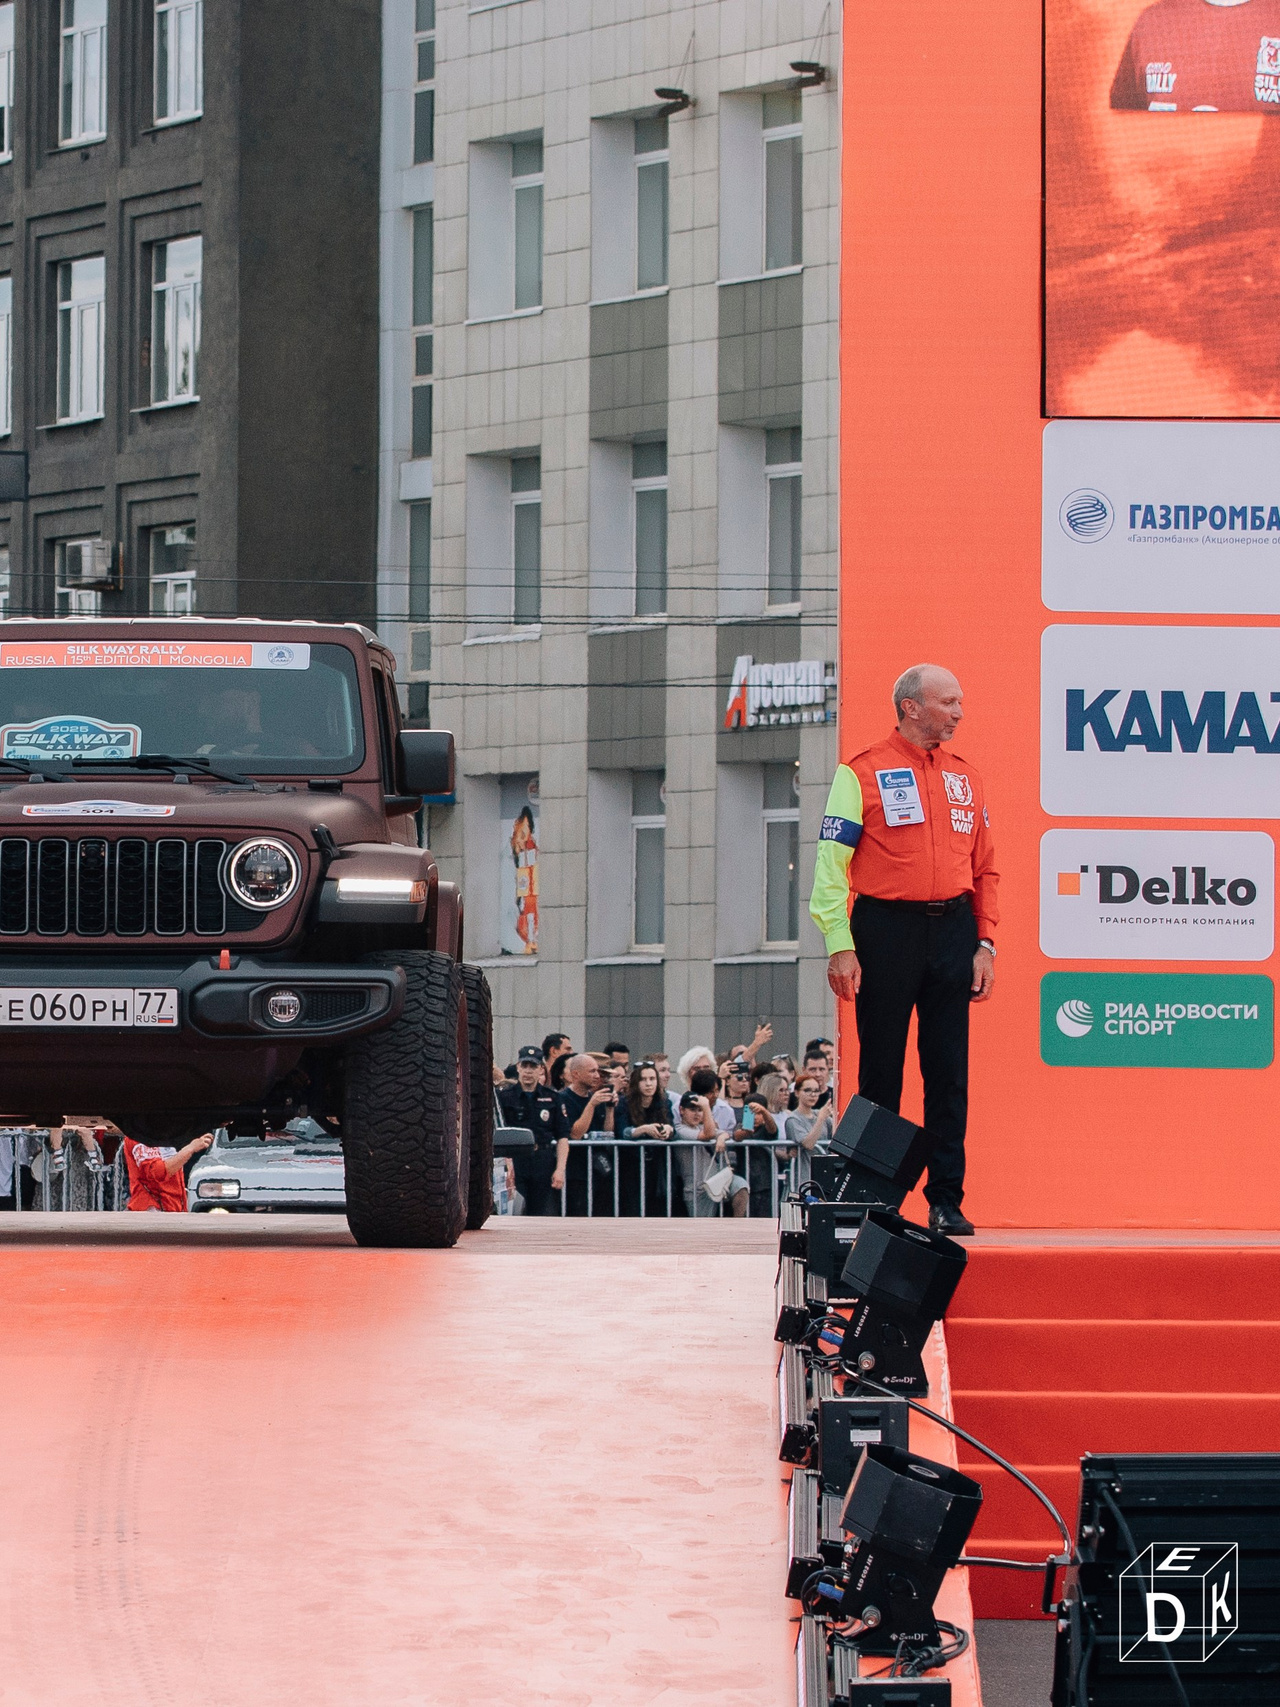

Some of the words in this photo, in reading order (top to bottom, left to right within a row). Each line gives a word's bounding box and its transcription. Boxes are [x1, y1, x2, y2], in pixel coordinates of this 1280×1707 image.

[1254, 75, 1280, 90] SIL
[1254, 87, 1280, 103] WA
[1129, 504, 1280, 531] ГАЗПРОМБА
[1127, 534, 1199, 545] «Газпромбанк»
[1201, 535, 1269, 546] (Акционерное
[66, 645, 98, 655] SILK
[102, 645, 136, 655] WAY
[139, 645, 186, 655] RALLY
[6, 656, 56, 665] RUSSIA
[71, 655, 91, 665] 15th
[95, 655, 151, 665] EDITION
[170, 655, 247, 665] MONGOLIA
[1065, 689, 1280, 754] KAMA
[49, 725, 89, 733] 2025
[12, 733, 70, 744] SILK
[73, 733, 126, 744] WAY
[950, 808, 975, 823] SILK
[951, 820, 974, 834] WAY
[1096, 864, 1257, 906] Delko
[1099, 916, 1187, 925] ТРАНСПОРТНАЯ
[1192, 918, 1255, 926] КОМПАНИЯ
[138, 992, 167, 1014] 77
[1104, 1002, 1149, 1019] РИА
[1155, 1003, 1258, 1020] НОВОСТИ
[136, 1015, 157, 1023] RUS
[1104, 1019, 1176, 1036] СПОРТ
[853, 1327, 862, 1338] LED
[856, 1578, 864, 1591] LED
